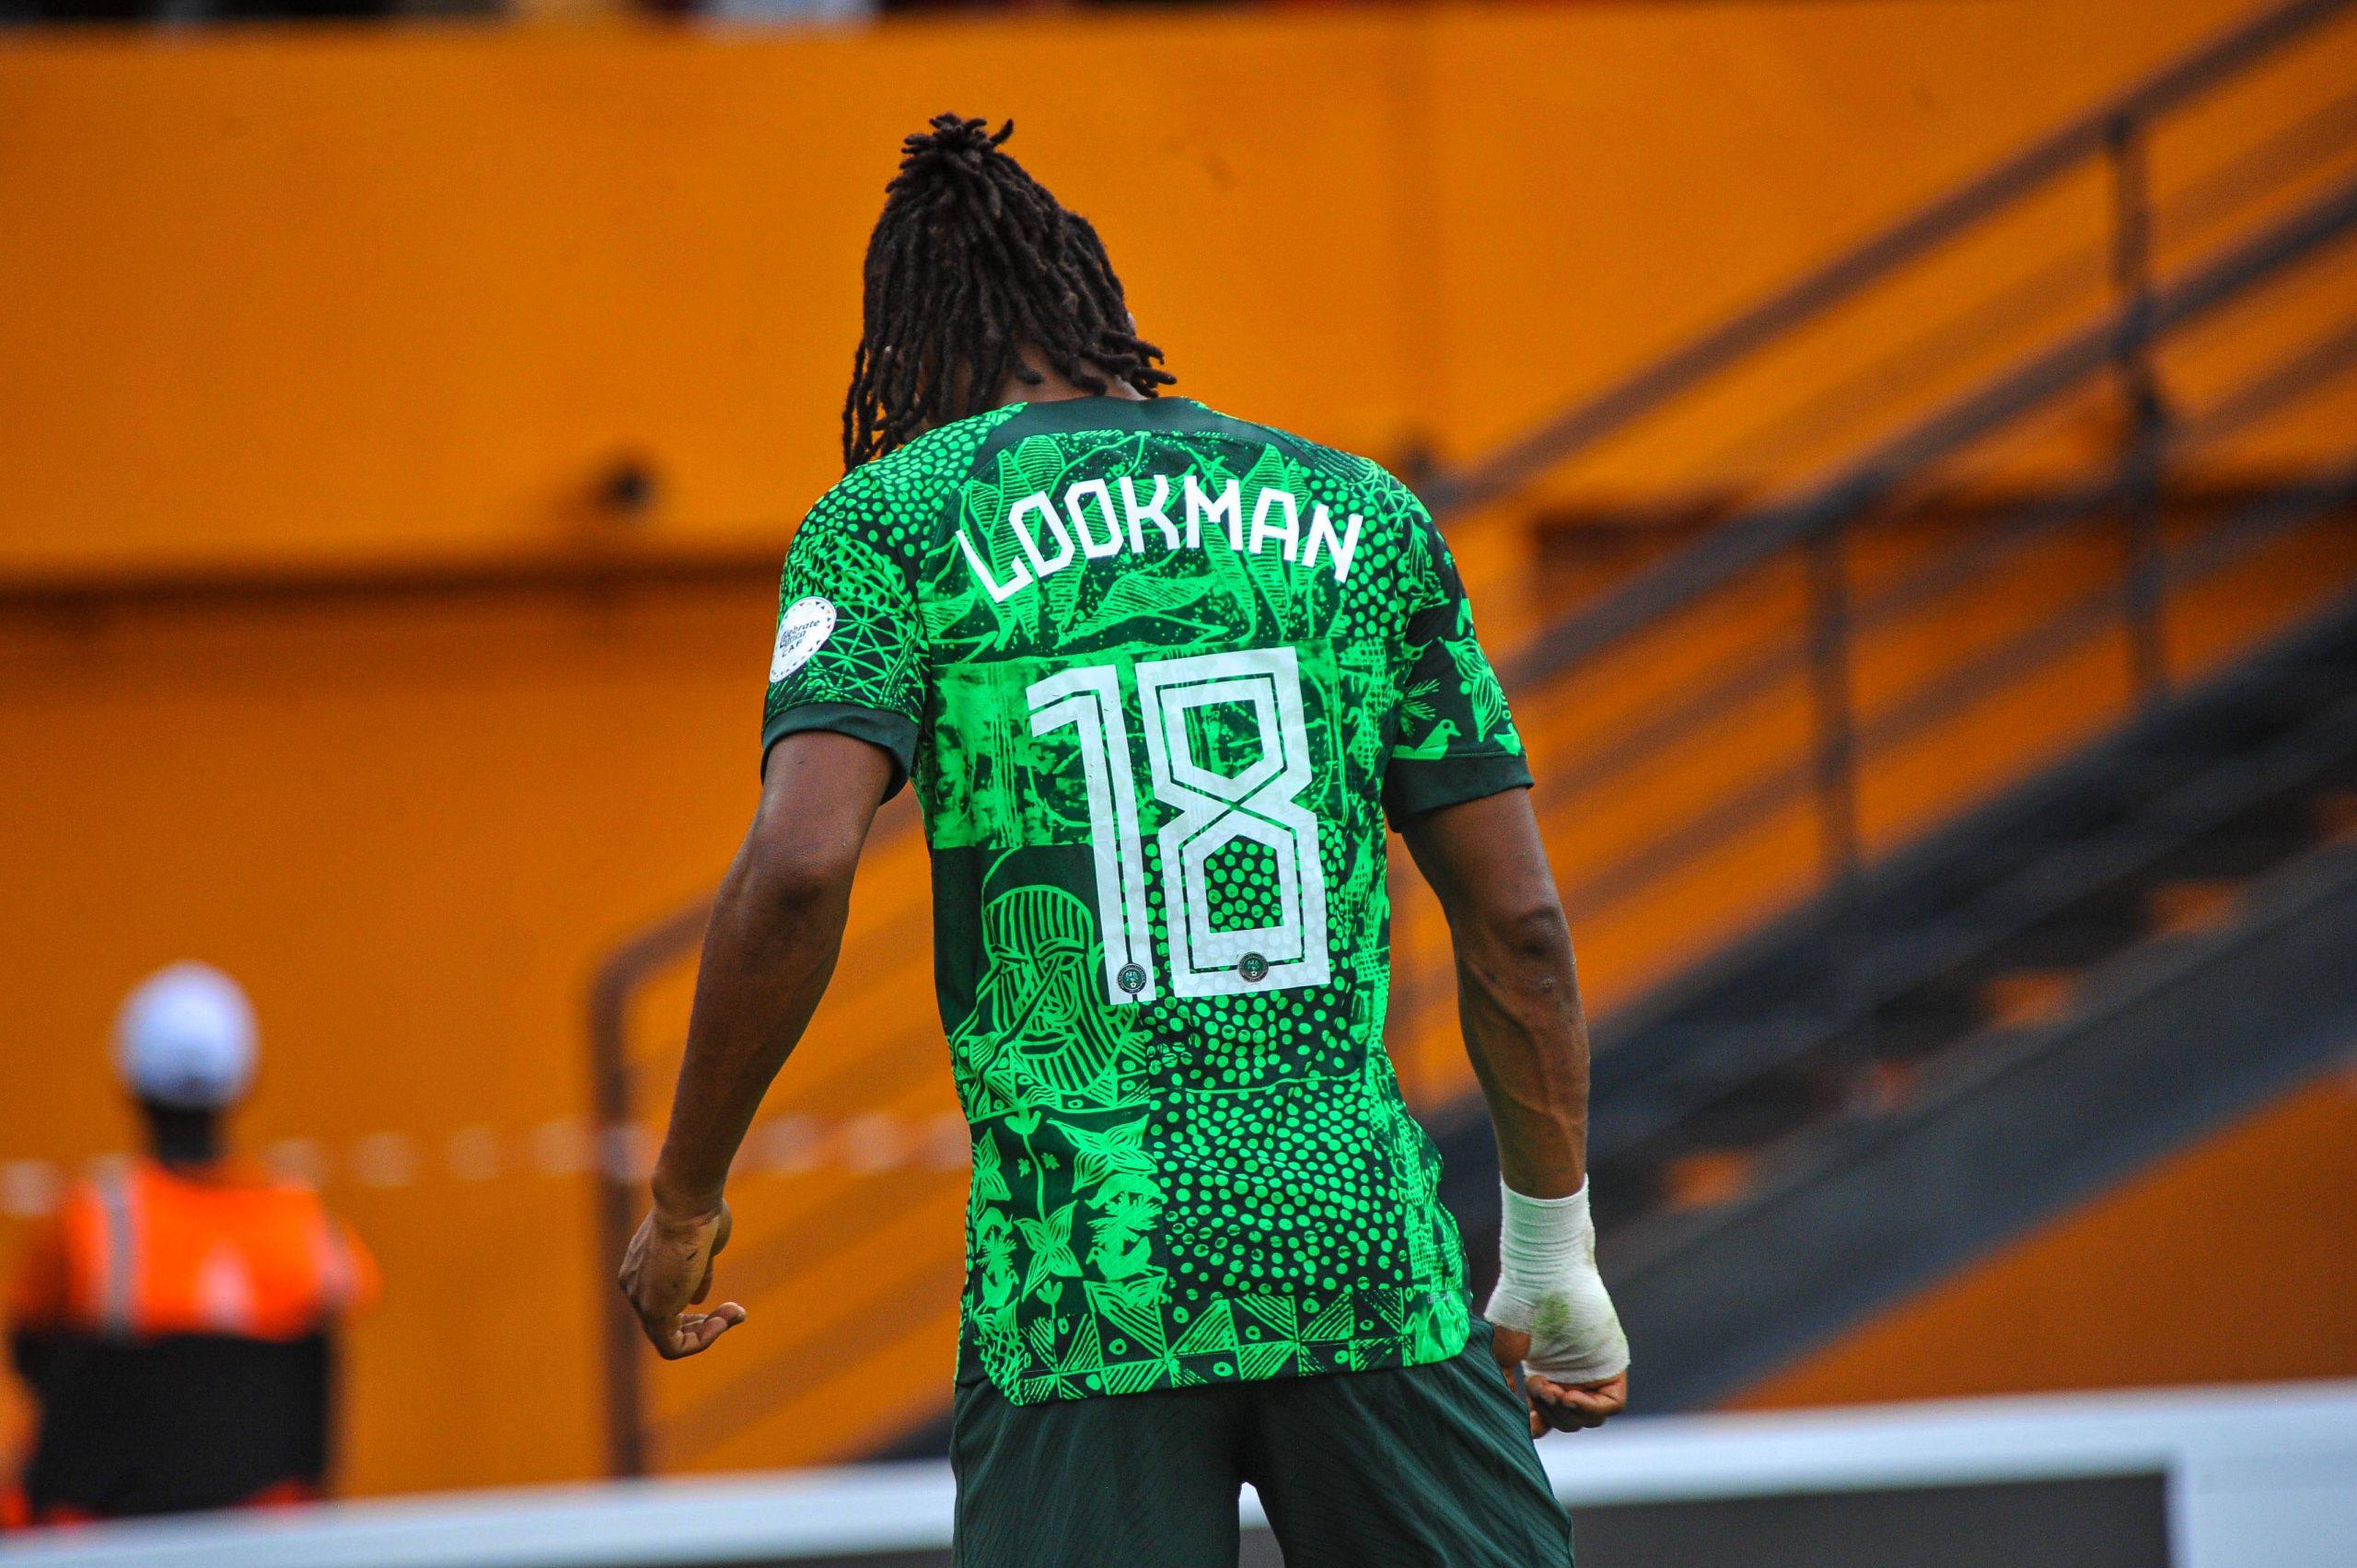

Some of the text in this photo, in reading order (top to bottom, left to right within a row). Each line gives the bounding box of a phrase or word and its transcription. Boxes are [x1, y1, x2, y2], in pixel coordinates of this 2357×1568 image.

[956, 475, 1364, 604] LOOKMAN
[782, 639, 803, 657] CAF
[1026, 646, 1331, 1005] 18
